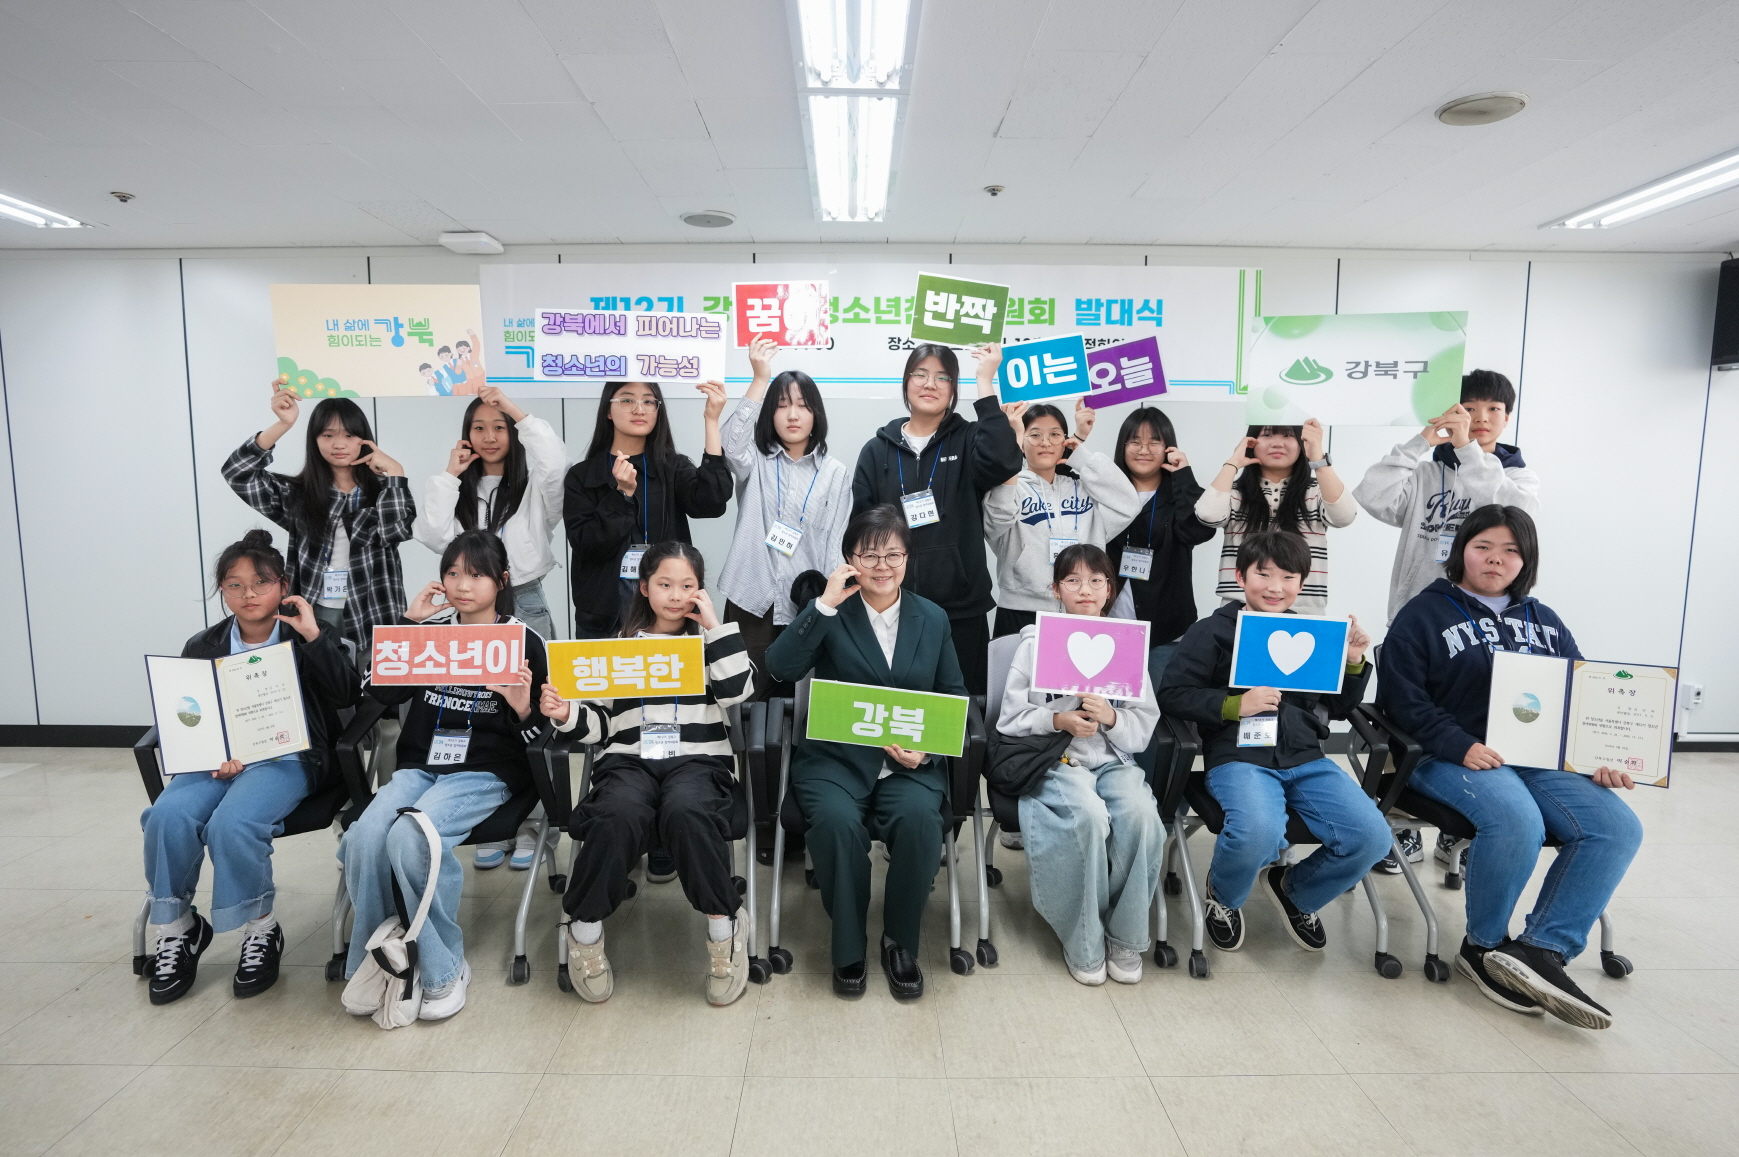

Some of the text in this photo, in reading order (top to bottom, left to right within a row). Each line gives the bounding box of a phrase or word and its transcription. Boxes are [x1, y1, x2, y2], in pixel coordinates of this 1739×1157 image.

[325, 319, 370, 331] 내 삶에
[541, 312, 721, 338] 강북에서 피어나는
[923, 290, 998, 335] 반짝
[1074, 298, 1163, 327] 발대식
[327, 334, 382, 347] 힘이되는
[888, 337, 915, 351] 장소
[541, 354, 627, 377] 청소년의
[636, 355, 699, 377] 가능성
[1006, 352, 1077, 388] 이는
[1089, 356, 1154, 396] 오늘
[1345, 360, 1429, 380] 강북구
[376, 639, 519, 676] 청소년이
[572, 654, 684, 691] 행복한
[852, 701, 925, 742] 강북
